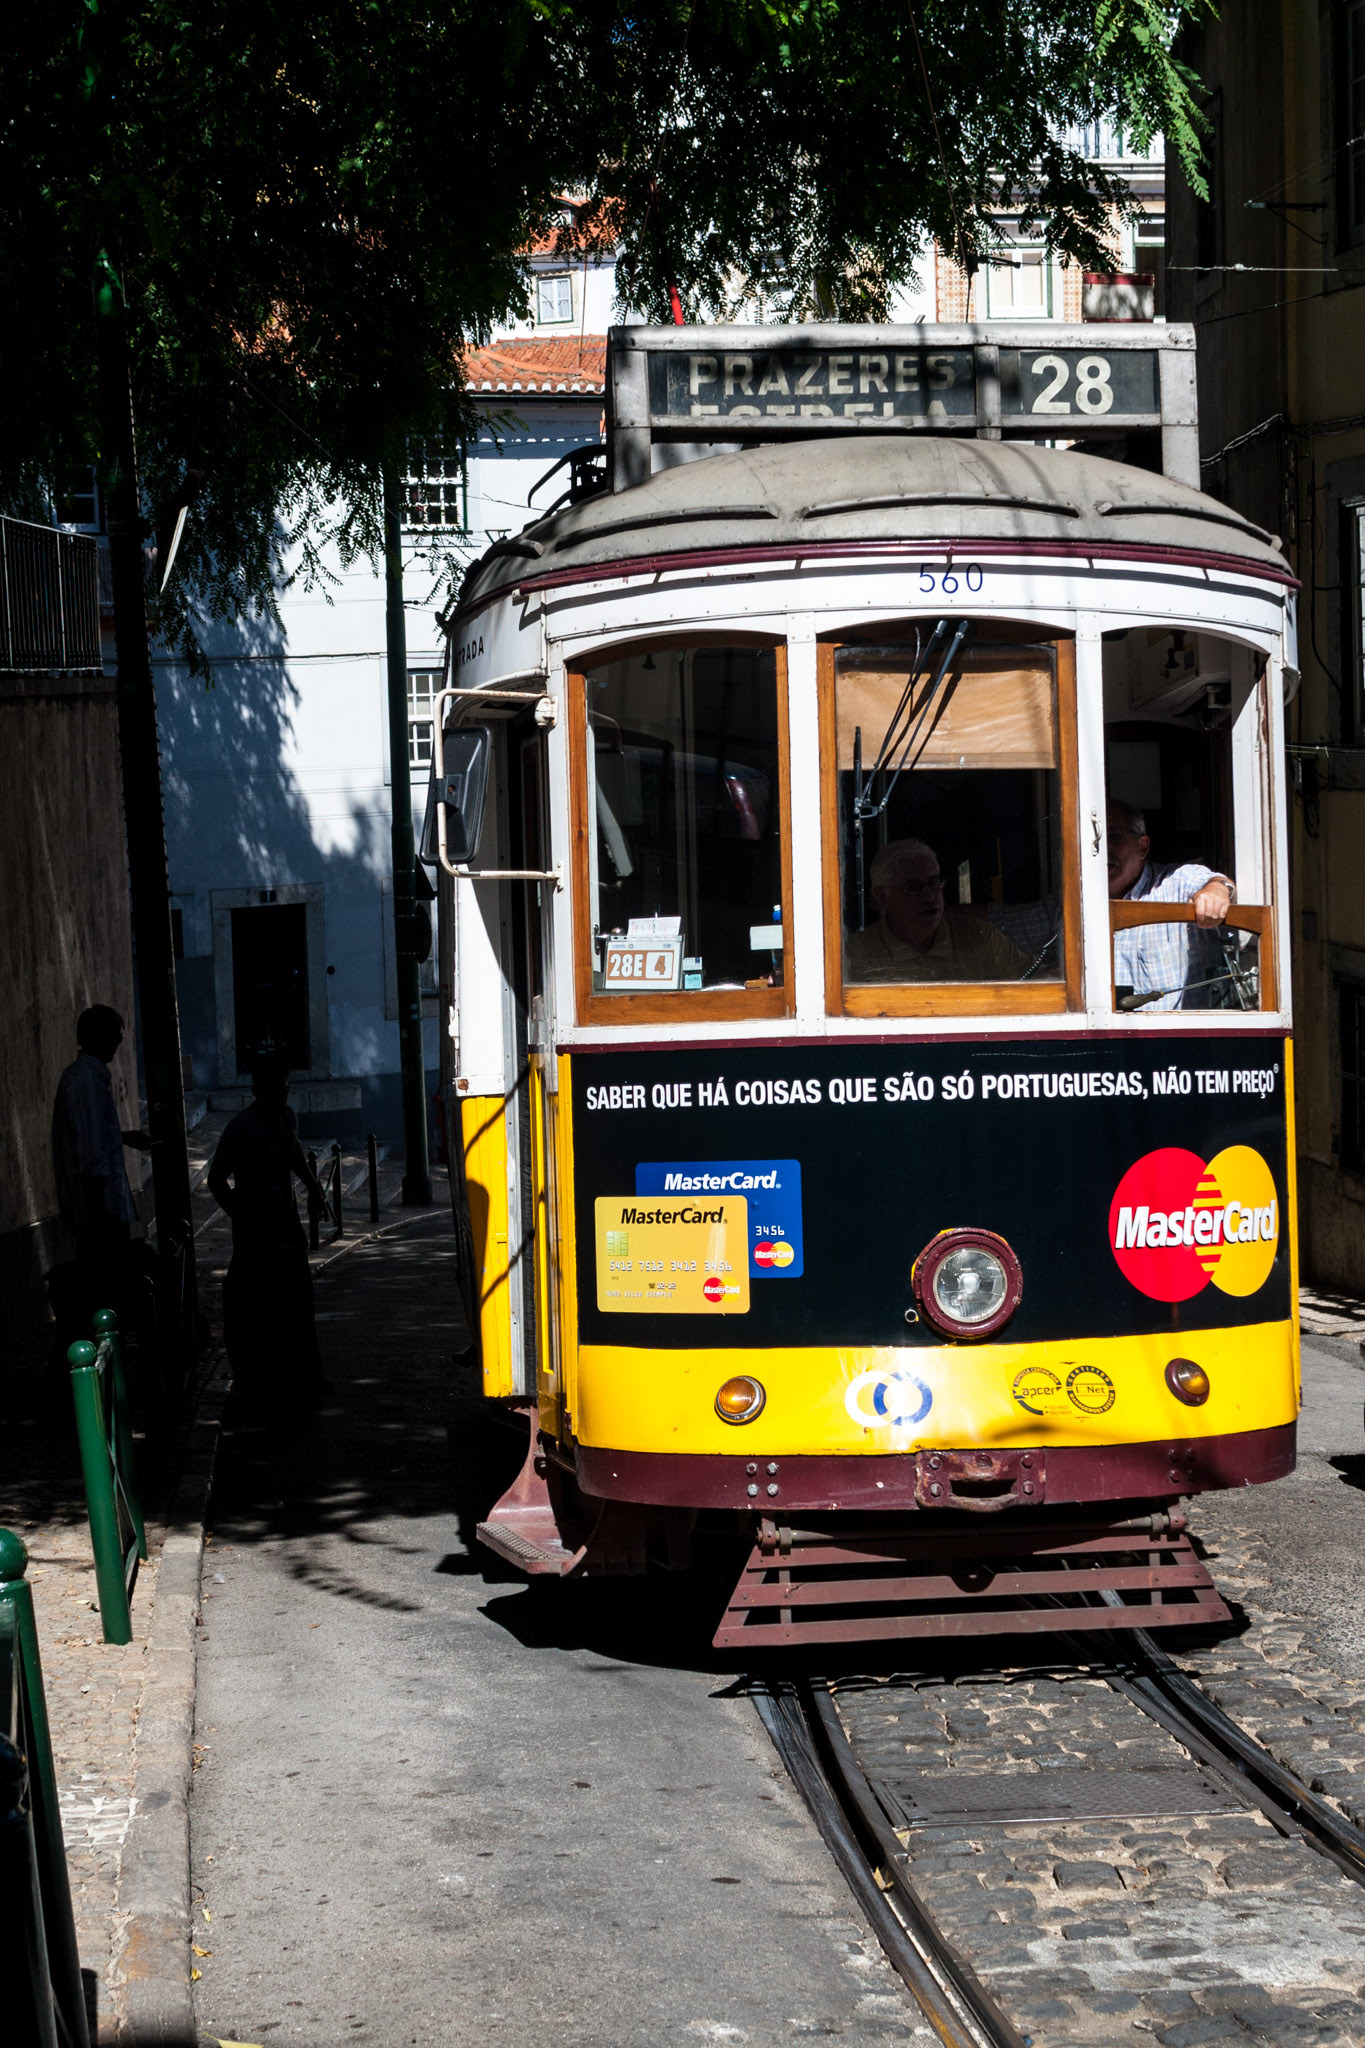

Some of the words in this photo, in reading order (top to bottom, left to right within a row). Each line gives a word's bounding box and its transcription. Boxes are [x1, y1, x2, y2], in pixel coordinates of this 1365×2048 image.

[688, 354, 956, 396] PRAZERES
[1030, 353, 1114, 416] 28
[918, 562, 984, 594] 560
[609, 953, 644, 978] 28E
[654, 955, 666, 976] 4
[586, 1084, 647, 1110] SABER
[651, 1082, 692, 1109] QUE
[698, 1076, 729, 1106] HÁ
[735, 1078, 822, 1106] COISAS
[828, 1078, 877, 1105] QUE
[883, 1071, 934, 1102] SÃO
[941, 1070, 975, 1100] SÓ
[981, 1070, 1149, 1100] PORTUGUESAS,
[1152, 1066, 1191, 1095] NÃO
[1195, 1070, 1229, 1094] TEM
[755, 1225, 785, 1236] 3456
[1114, 1199, 1277, 1250] MasterCard
[609, 1260, 633, 1272] 5412
[638, 1260, 664, 1272] 7512
[670, 1260, 697, 1272] 3412
[704, 1260, 732, 1272] 3456
[754, 1250, 793, 1259] MasterCard
[703, 1285, 740, 1295] MasterCard
[1021, 1387, 1055, 1399] apcer
